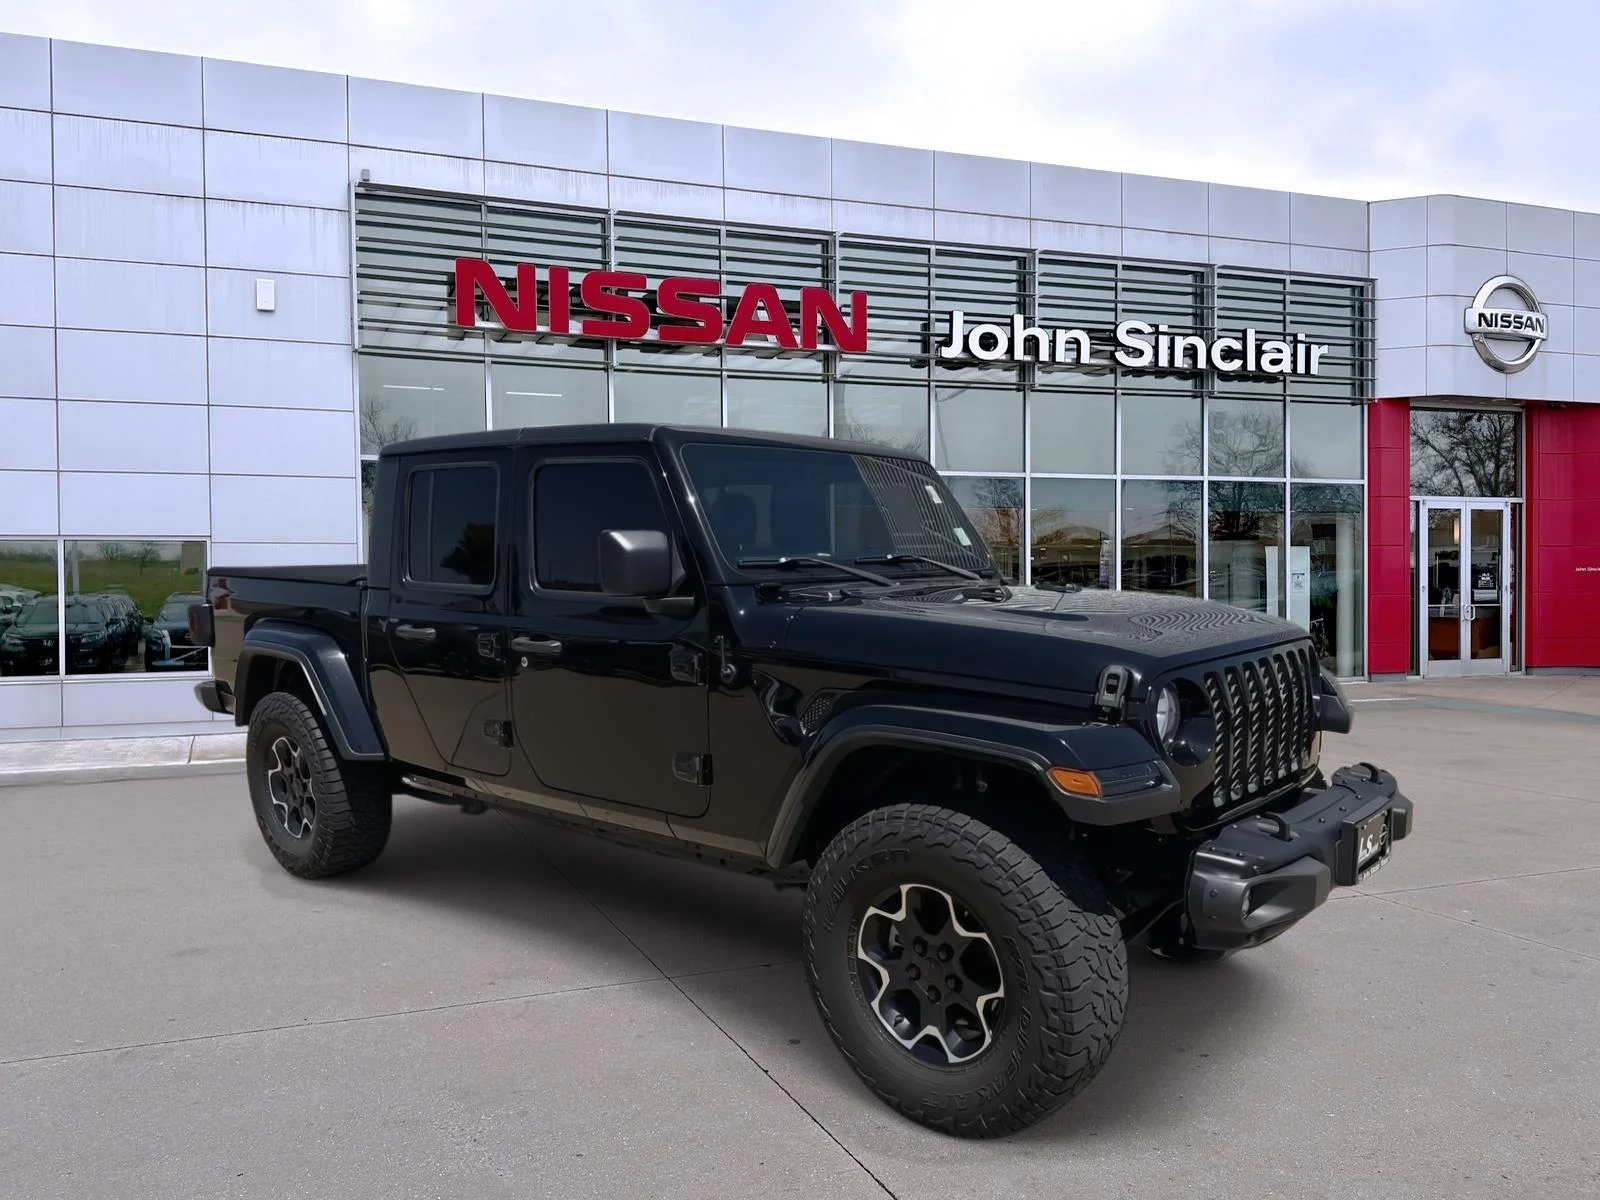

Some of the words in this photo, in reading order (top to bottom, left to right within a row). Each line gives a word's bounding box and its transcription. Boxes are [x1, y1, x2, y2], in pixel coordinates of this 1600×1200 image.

[454, 257, 868, 353] NISSAN
[1478, 312, 1545, 333] NISSAN
[940, 310, 1090, 363] John
[1114, 319, 1329, 375] Sinclair
